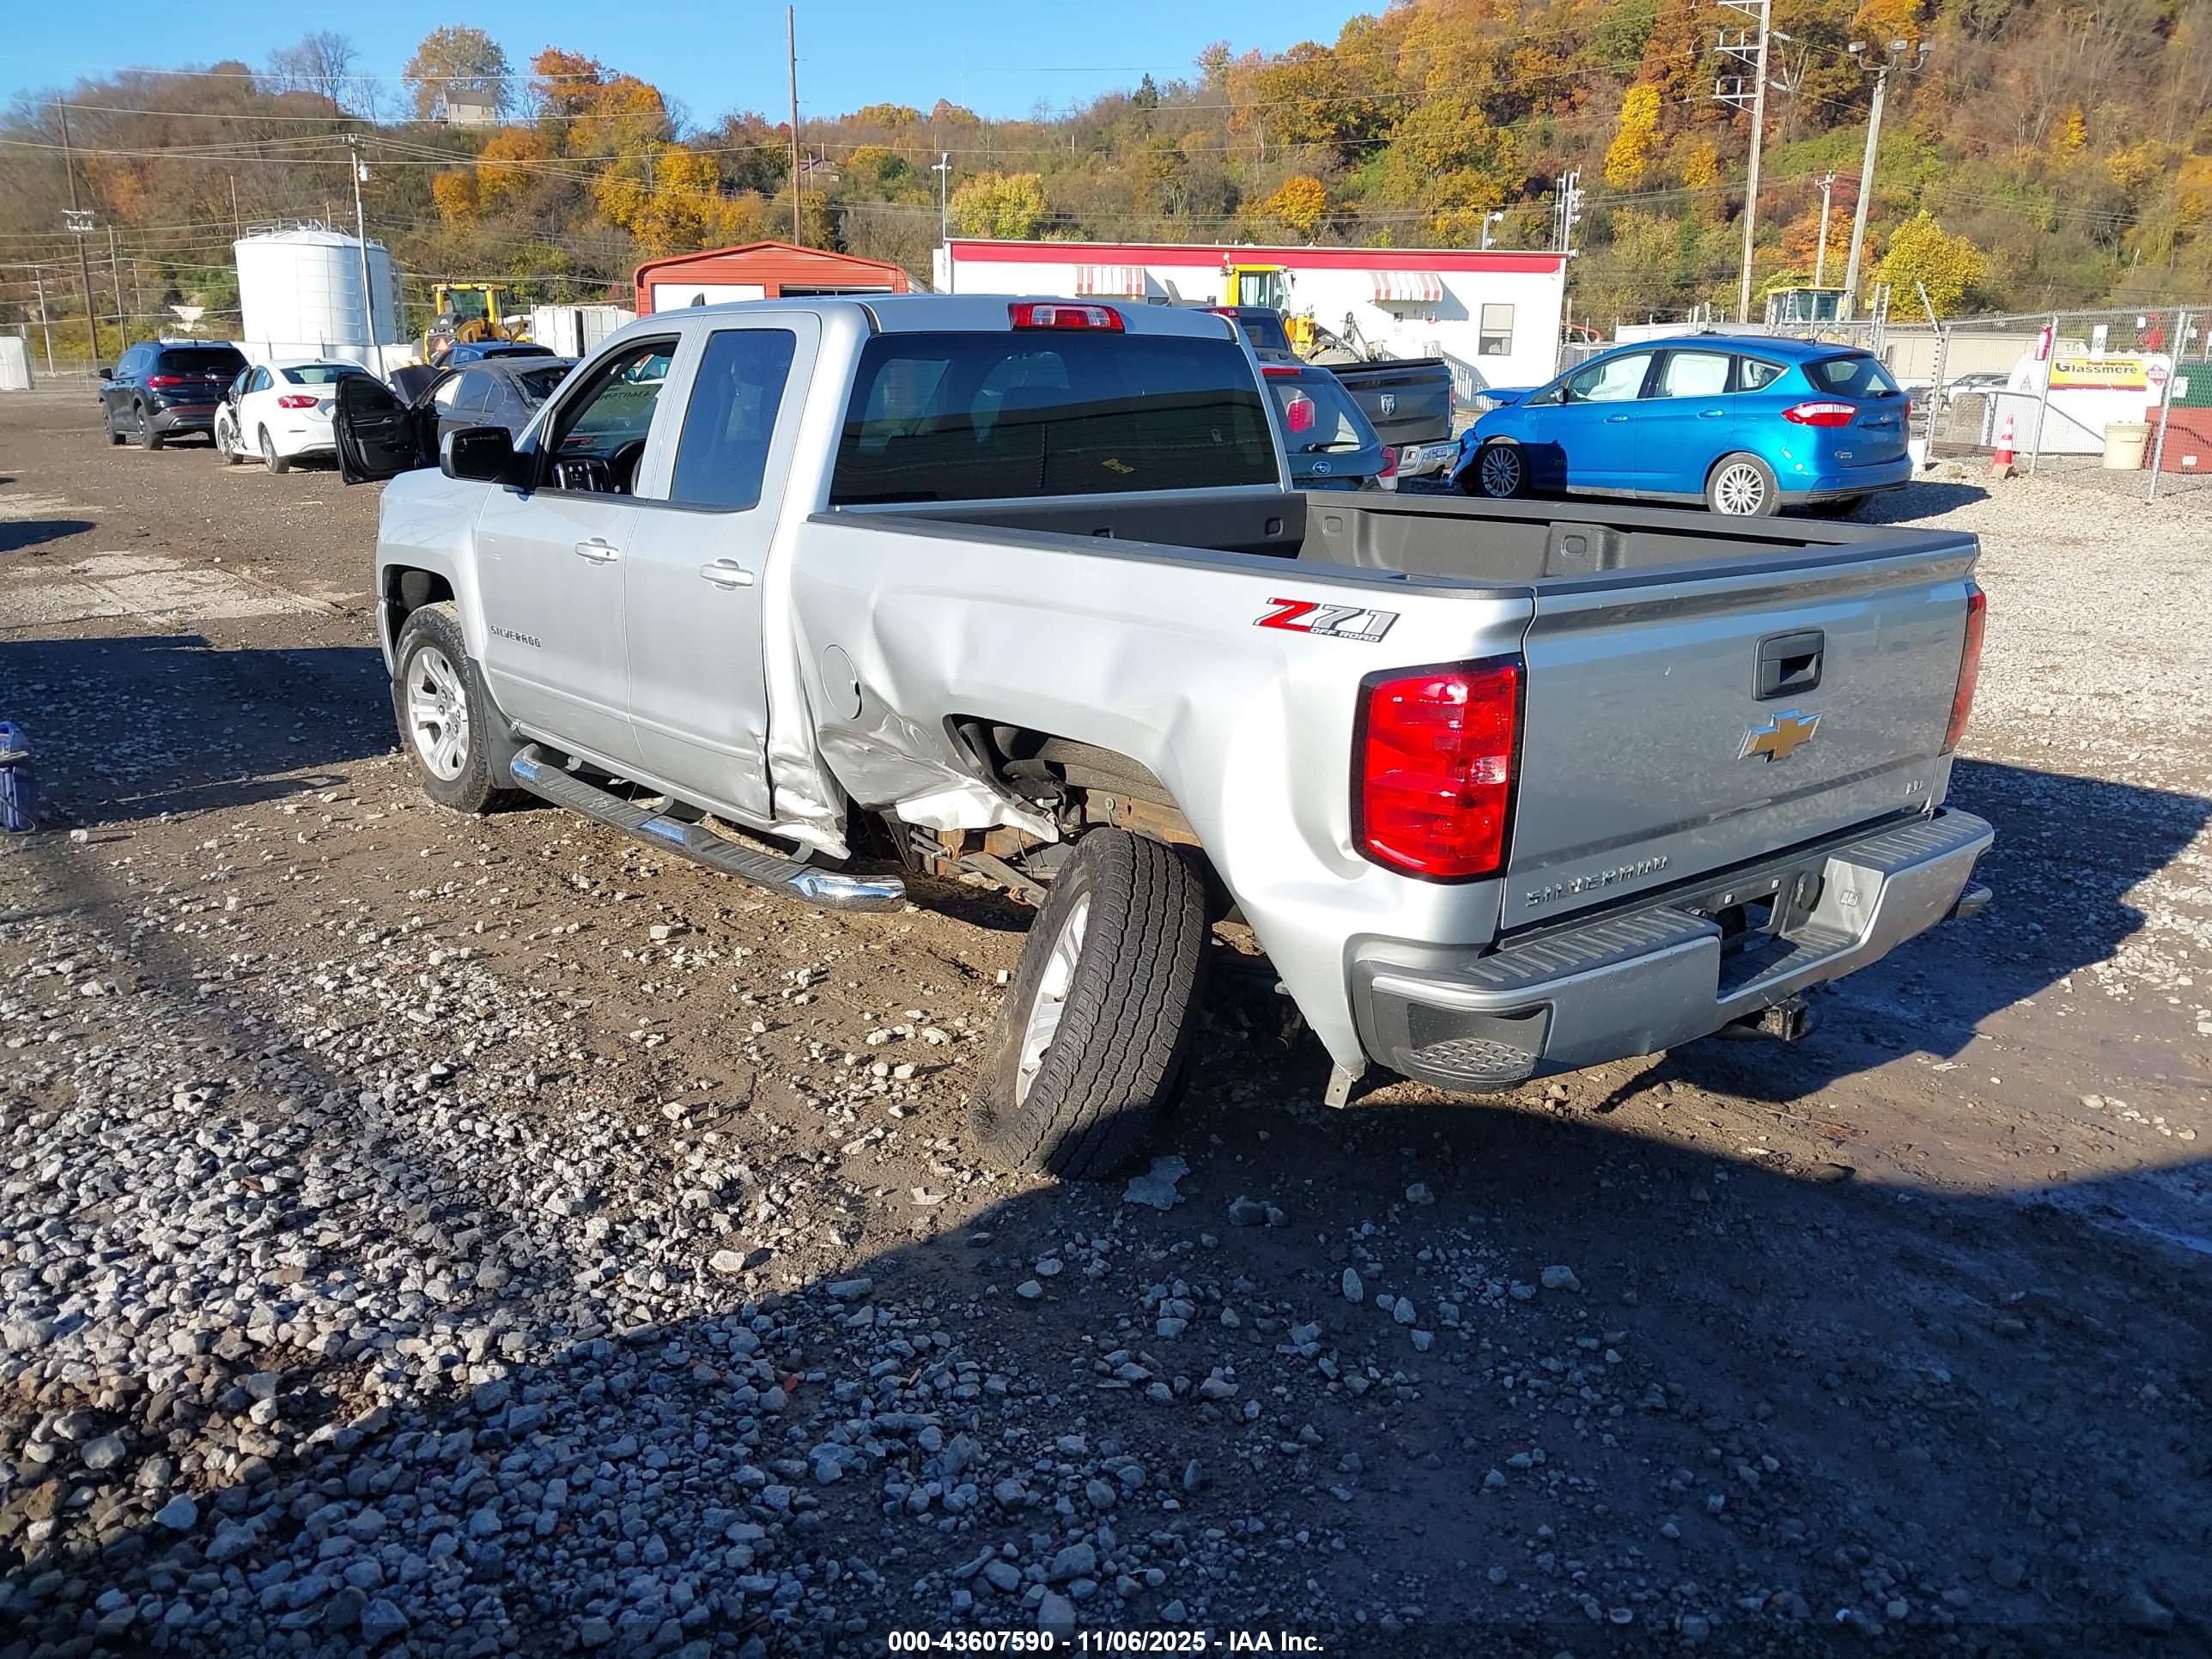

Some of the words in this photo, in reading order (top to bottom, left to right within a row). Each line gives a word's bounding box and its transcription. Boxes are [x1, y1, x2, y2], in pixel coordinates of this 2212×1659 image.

[2055, 362, 2138, 374] Glassmere
[1253, 597, 1401, 641] Z71
[490, 625, 542, 648] SILVERADO
[1310, 627, 1337, 638] OFF
[1338, 630, 1381, 643] ROAD
[1525, 855, 1668, 908] SILVERADO
